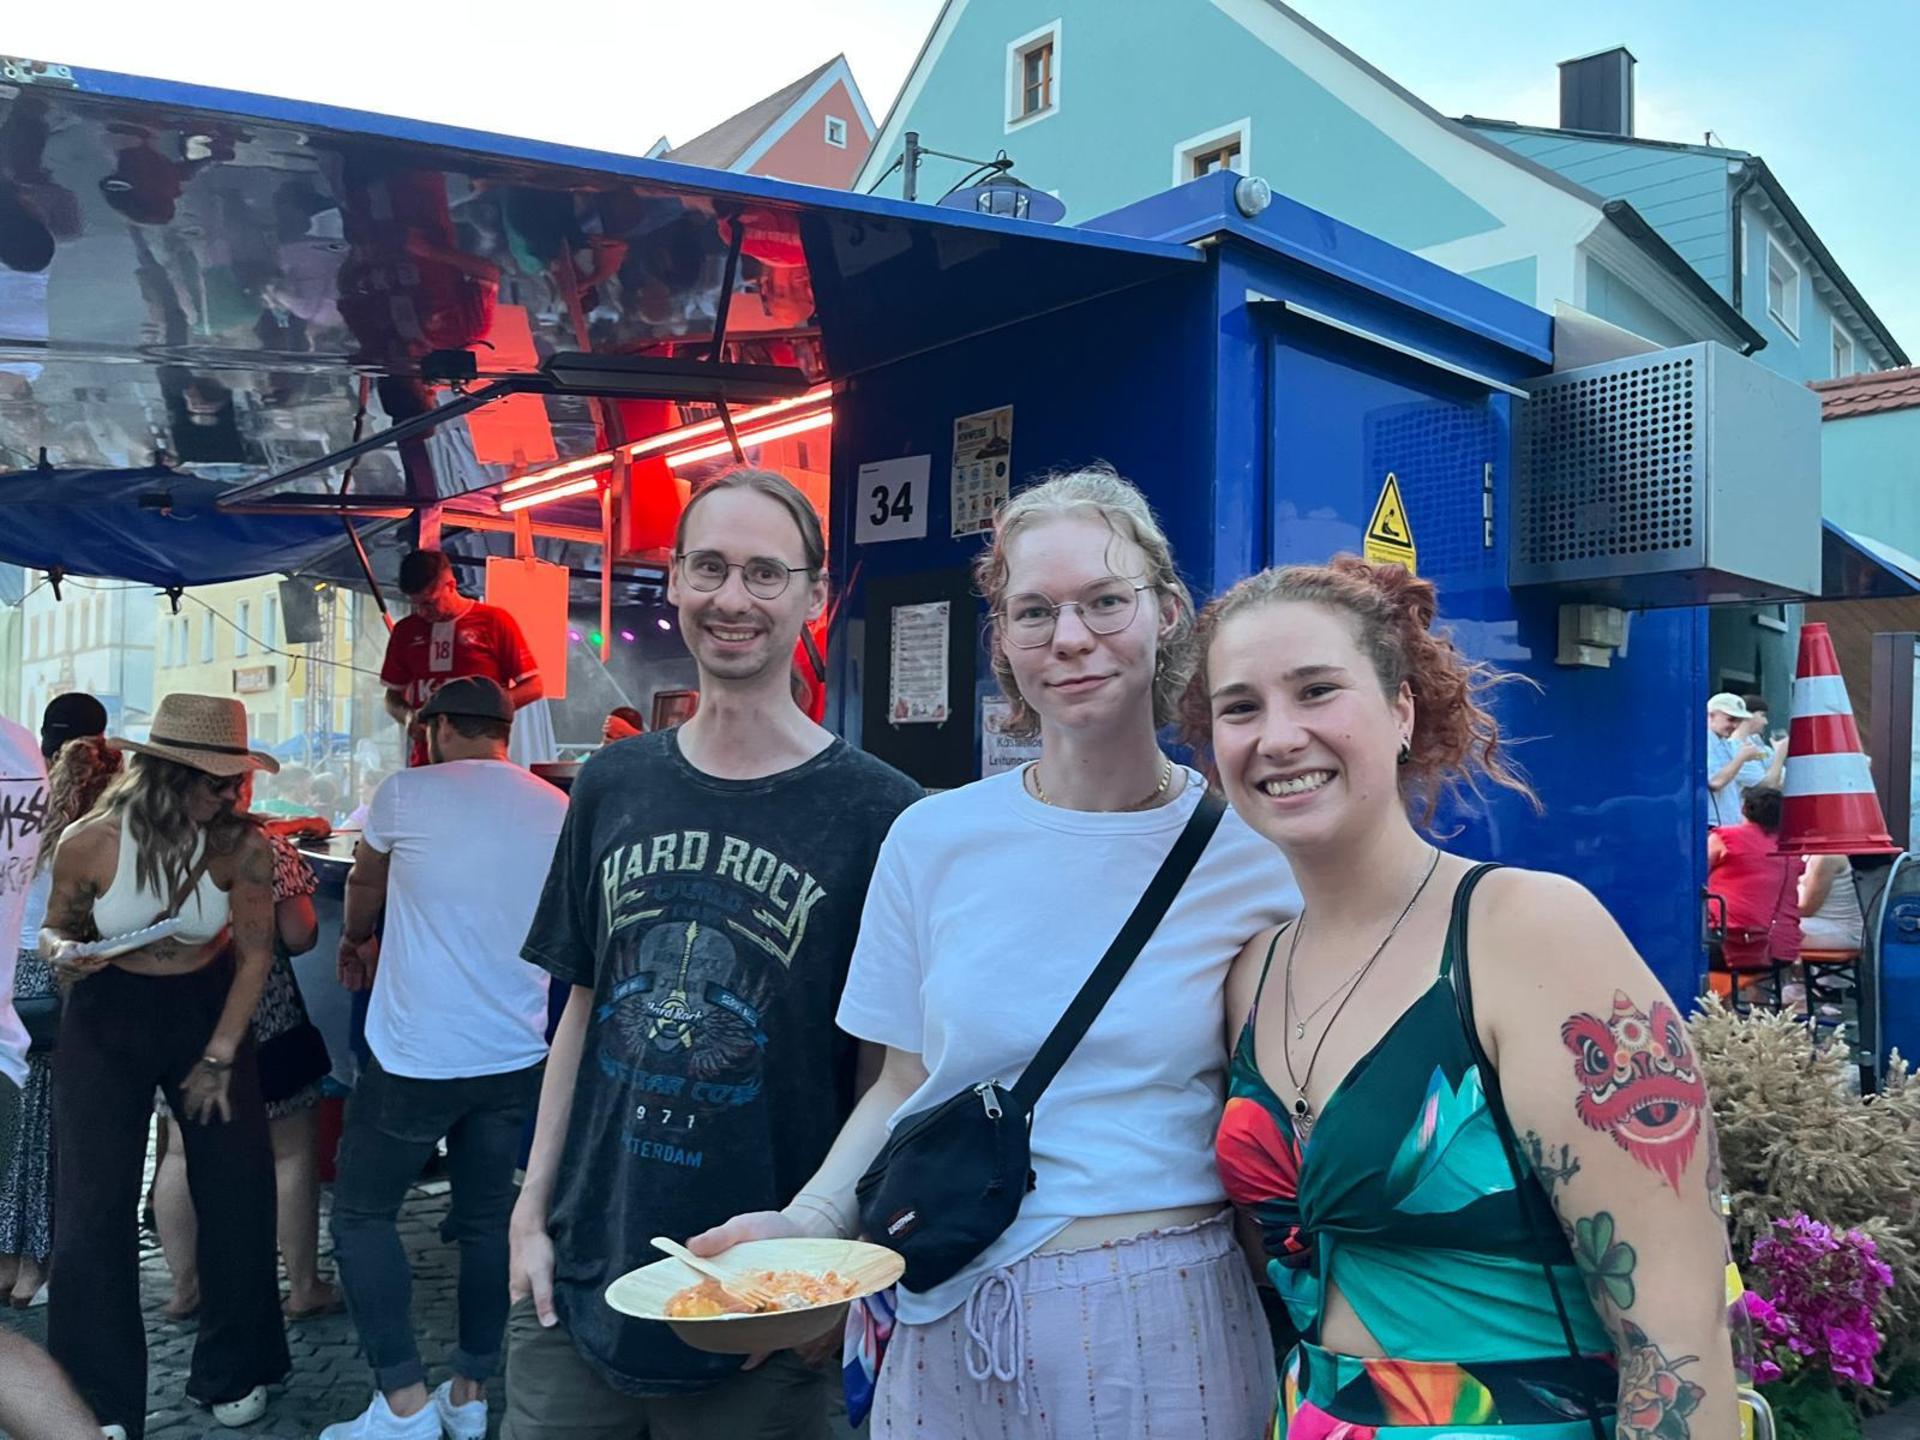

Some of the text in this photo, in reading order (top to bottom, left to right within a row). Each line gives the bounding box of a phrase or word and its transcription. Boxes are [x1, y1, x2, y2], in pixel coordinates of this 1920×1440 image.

[869, 481, 914, 526] 34
[434, 641, 450, 660] 18
[602, 830, 827, 970] HARD ROCK
